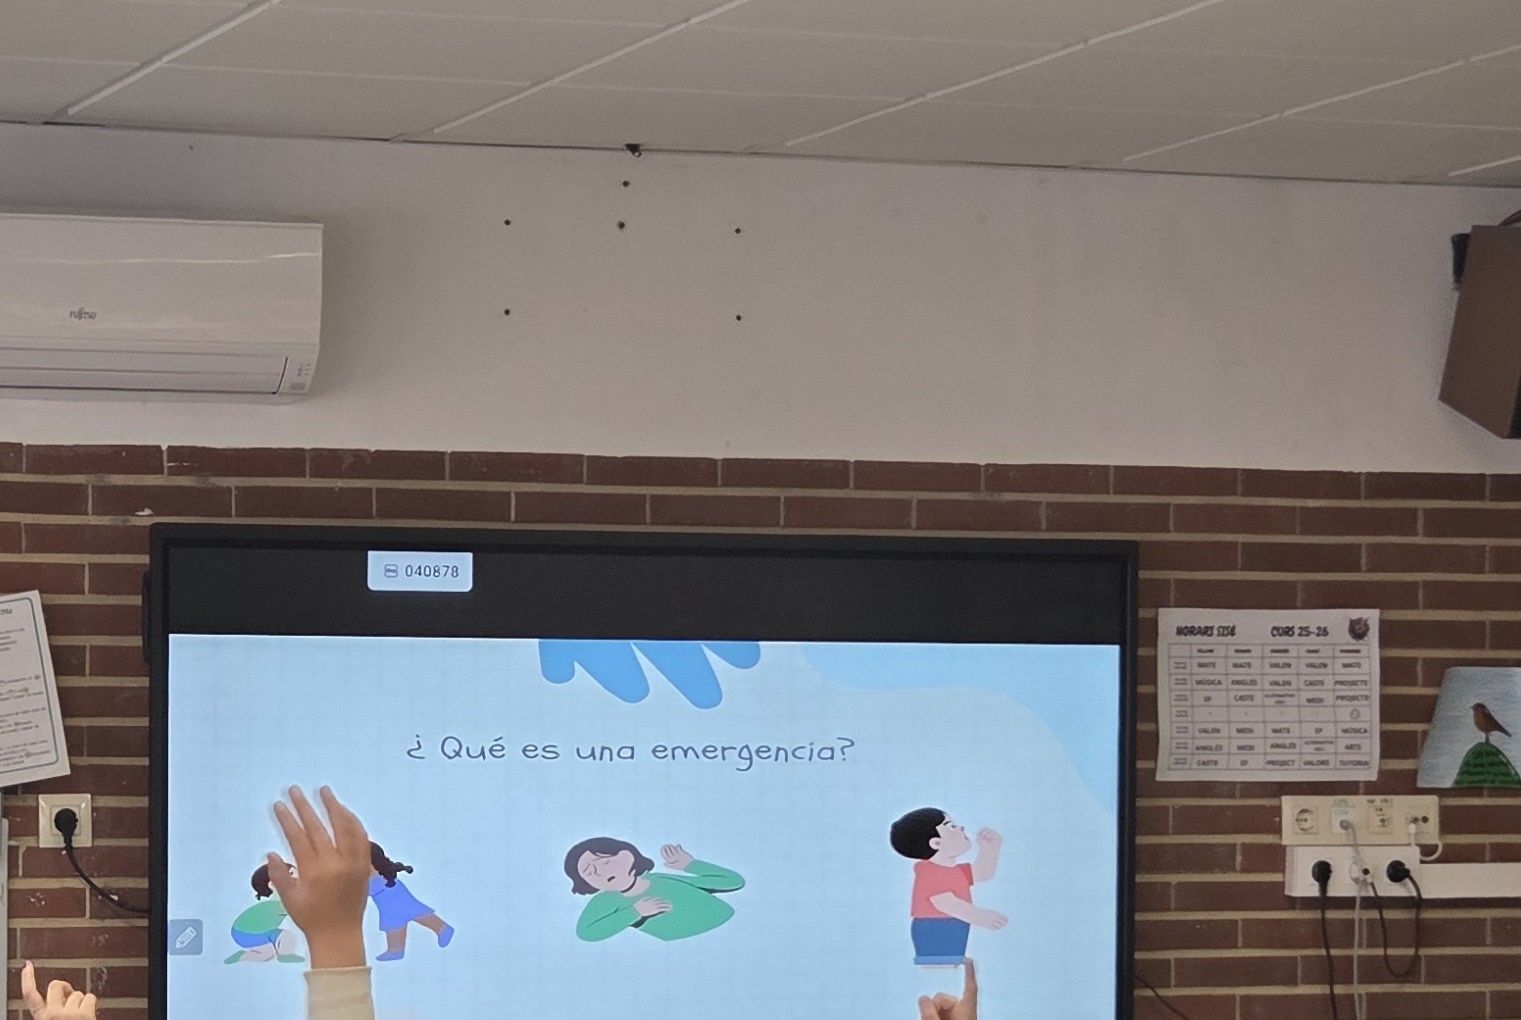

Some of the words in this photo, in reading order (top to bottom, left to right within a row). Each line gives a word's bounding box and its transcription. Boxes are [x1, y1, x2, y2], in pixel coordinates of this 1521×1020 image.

[404, 564, 460, 578] 040878
[1270, 625, 1295, 638] CURS
[1297, 625, 1330, 638] 25-26
[440, 736, 507, 761] Qué
[521, 743, 561, 760] es
[575, 743, 636, 762] una
[651, 736, 856, 772] emergencia?
